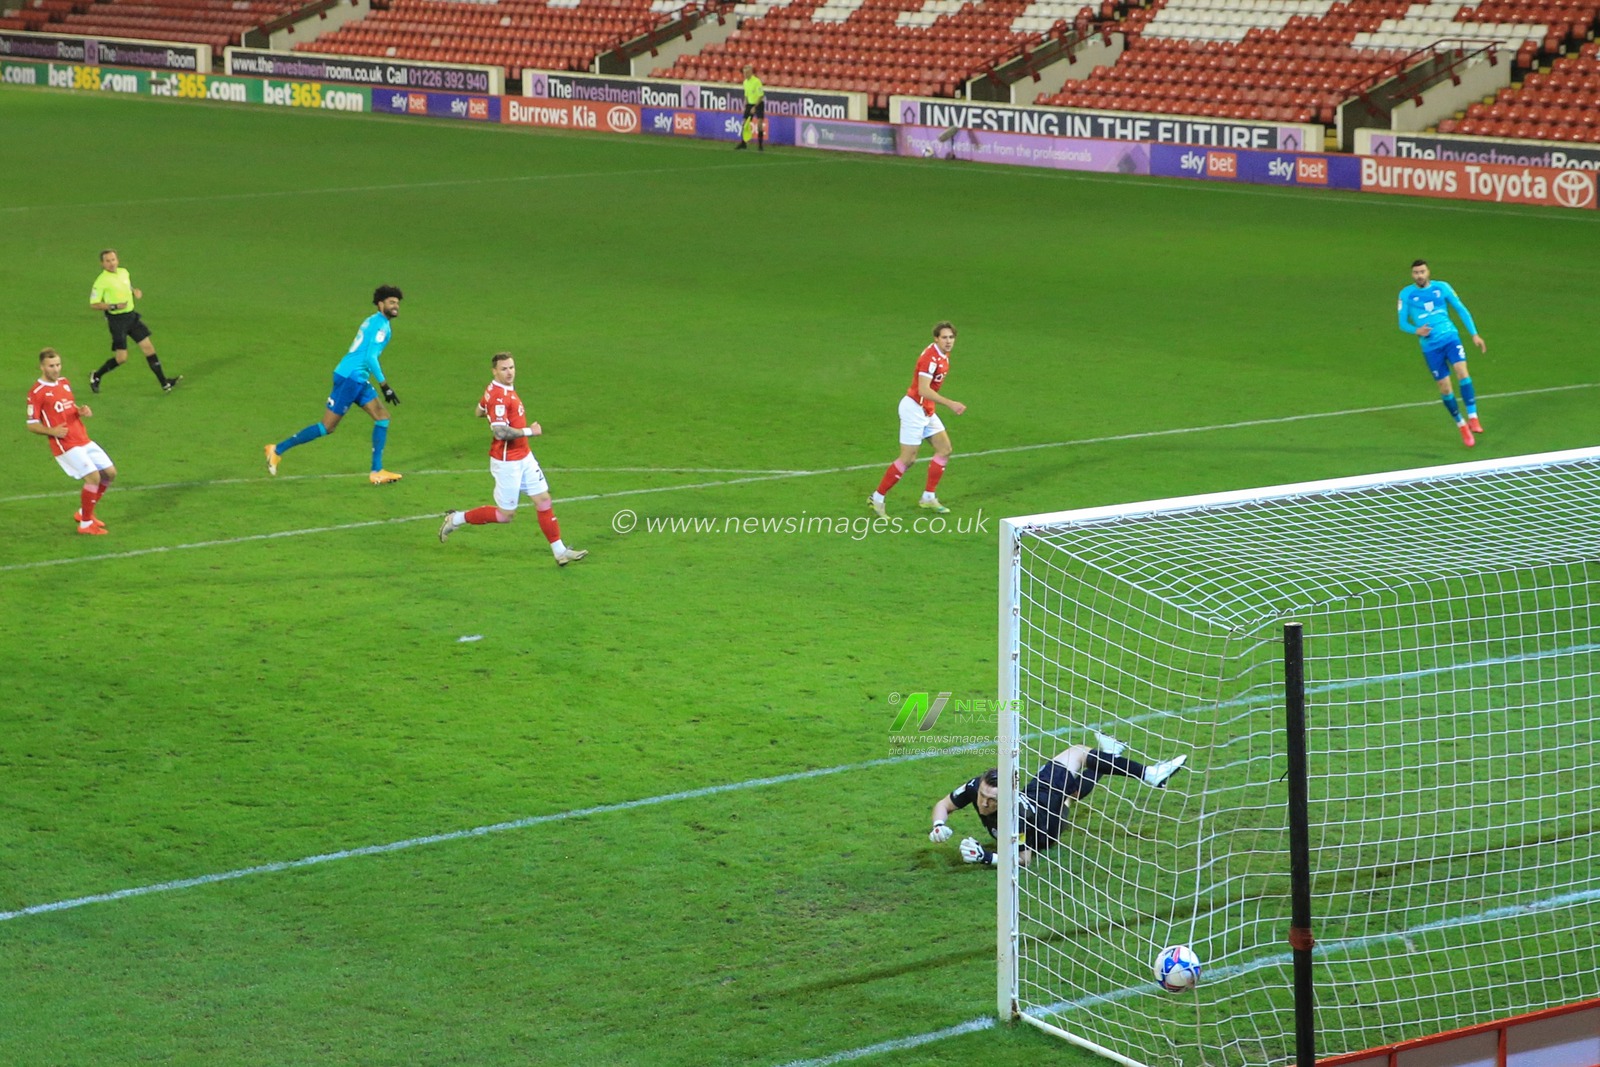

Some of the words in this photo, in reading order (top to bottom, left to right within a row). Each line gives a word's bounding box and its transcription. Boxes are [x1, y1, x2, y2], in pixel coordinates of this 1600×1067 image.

[48, 62, 138, 92] bet365.com
[386, 67, 408, 84] Call
[409, 68, 443, 87] 01226
[443, 71, 465, 88] 392
[466, 73, 488, 91] 940
[263, 79, 363, 112] bet365.com
[391, 93, 408, 112] sky
[409, 97, 426, 111] bet
[450, 98, 468, 117] sky
[469, 99, 487, 115] bet
[508, 100, 569, 126] Burrows
[572, 105, 597, 128] Kia
[654, 112, 673, 133] sky
[674, 114, 694, 130] bet
[926, 103, 1059, 136] INVESTING
[1065, 114, 1092, 138] IN
[1097, 118, 1150, 141] THE
[1157, 122, 1269, 149] FUTURE
[1180, 151, 1206, 175] sky
[1209, 153, 1234, 172] bet
[1268, 157, 1295, 181] sky
[1299, 159, 1325, 179] bet
[1361, 158, 1458, 193] Burrows
[1465, 165, 1548, 202] Toyota
